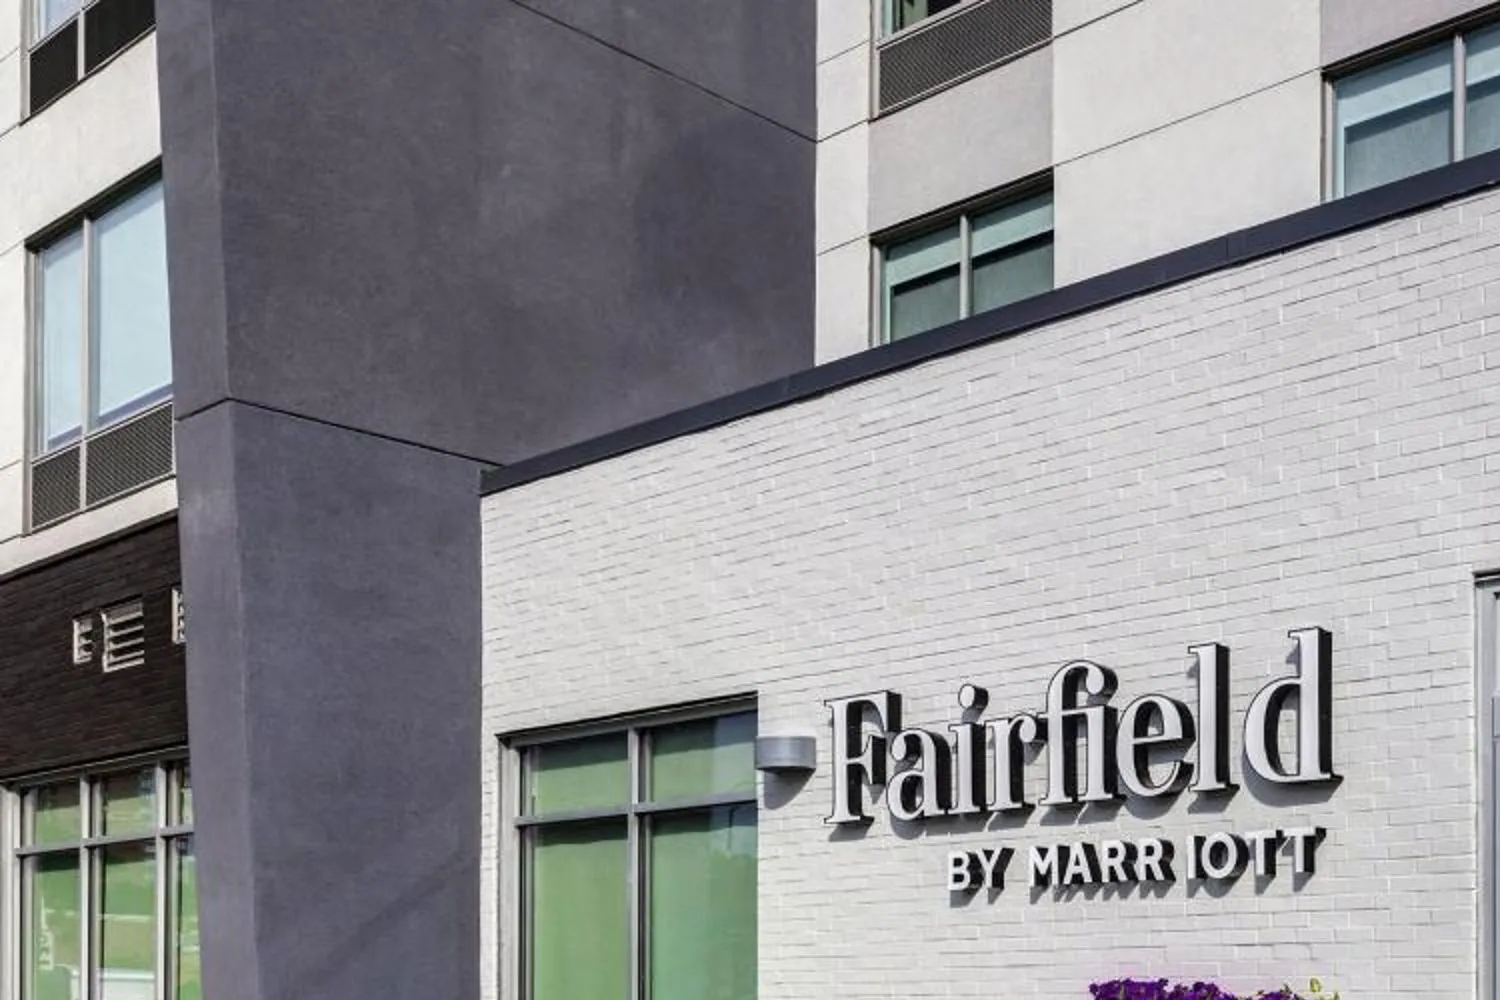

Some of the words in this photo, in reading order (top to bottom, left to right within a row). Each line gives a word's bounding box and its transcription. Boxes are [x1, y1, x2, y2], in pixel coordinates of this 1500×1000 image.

[824, 626, 1342, 825] Fairfield
[948, 847, 1013, 891] BY
[1029, 827, 1327, 888] MARRIOTT
